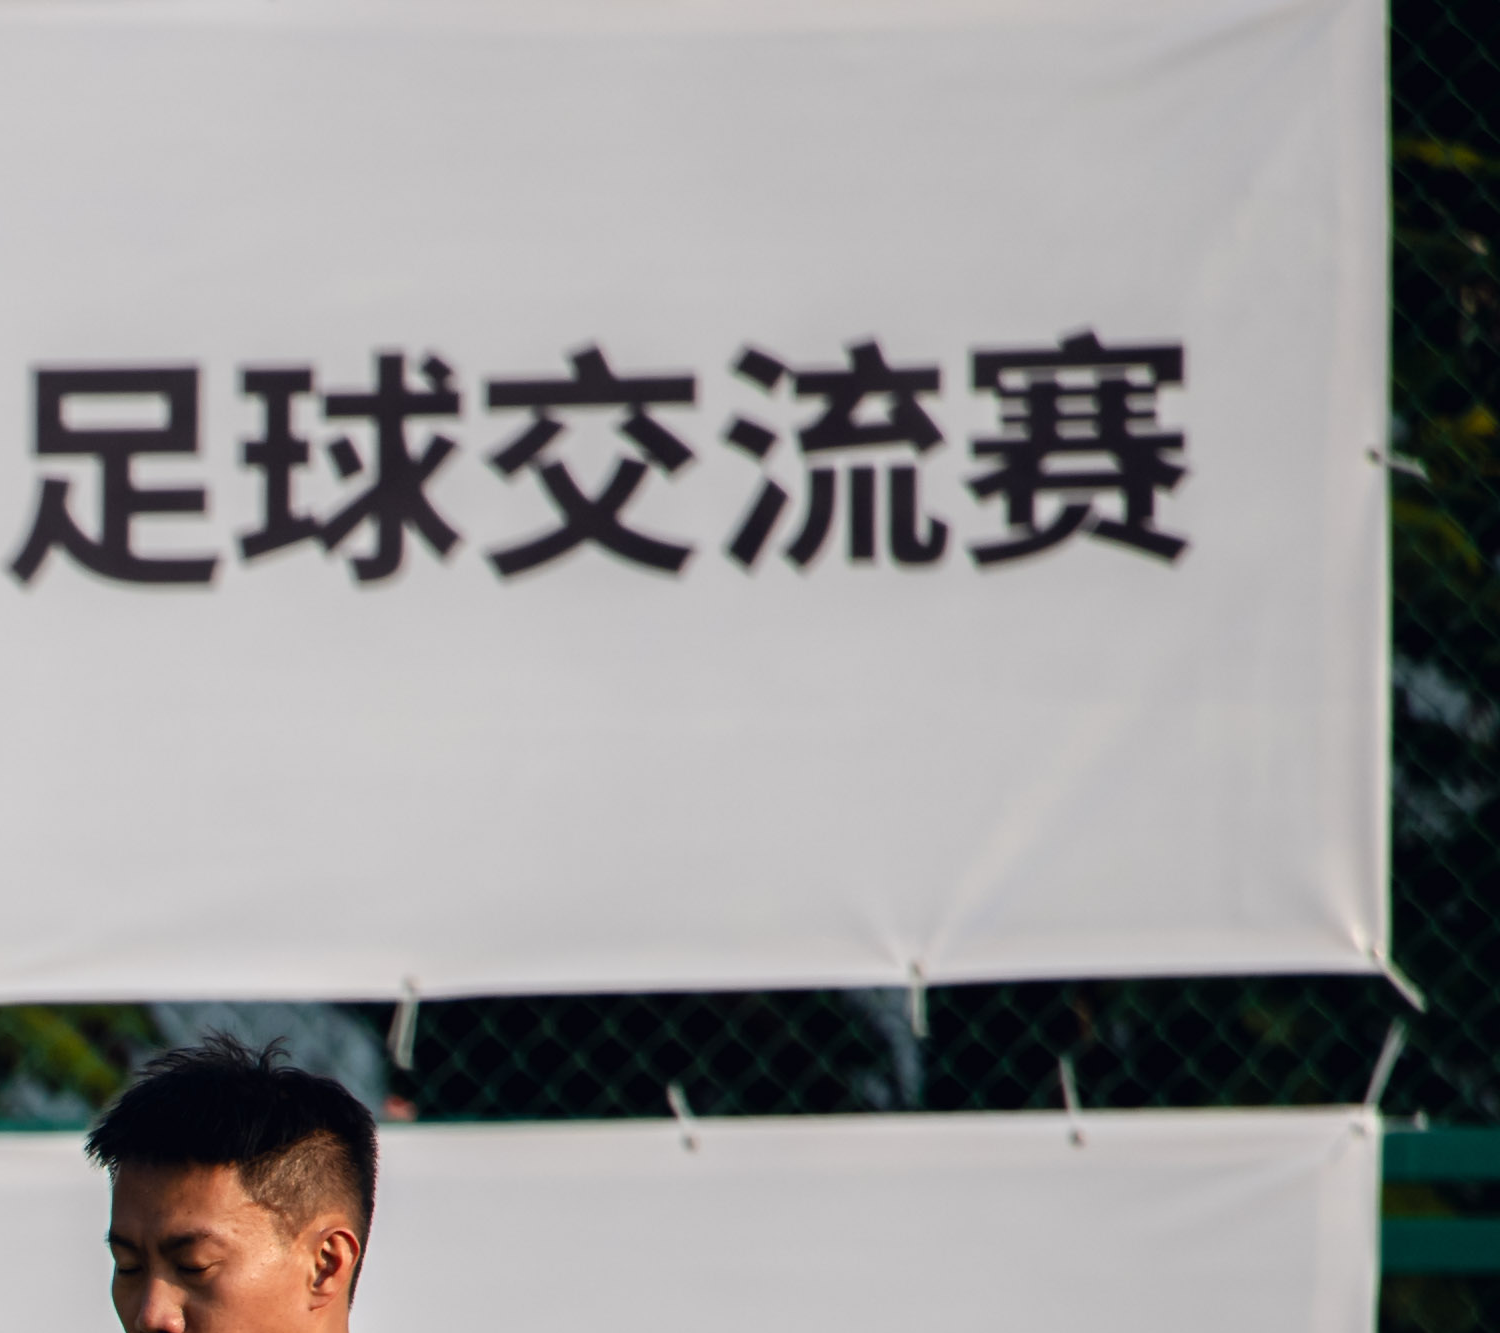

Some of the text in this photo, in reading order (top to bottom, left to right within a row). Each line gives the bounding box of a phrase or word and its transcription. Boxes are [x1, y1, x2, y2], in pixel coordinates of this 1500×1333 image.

[6, 329, 1191, 587] 足球交流赛
